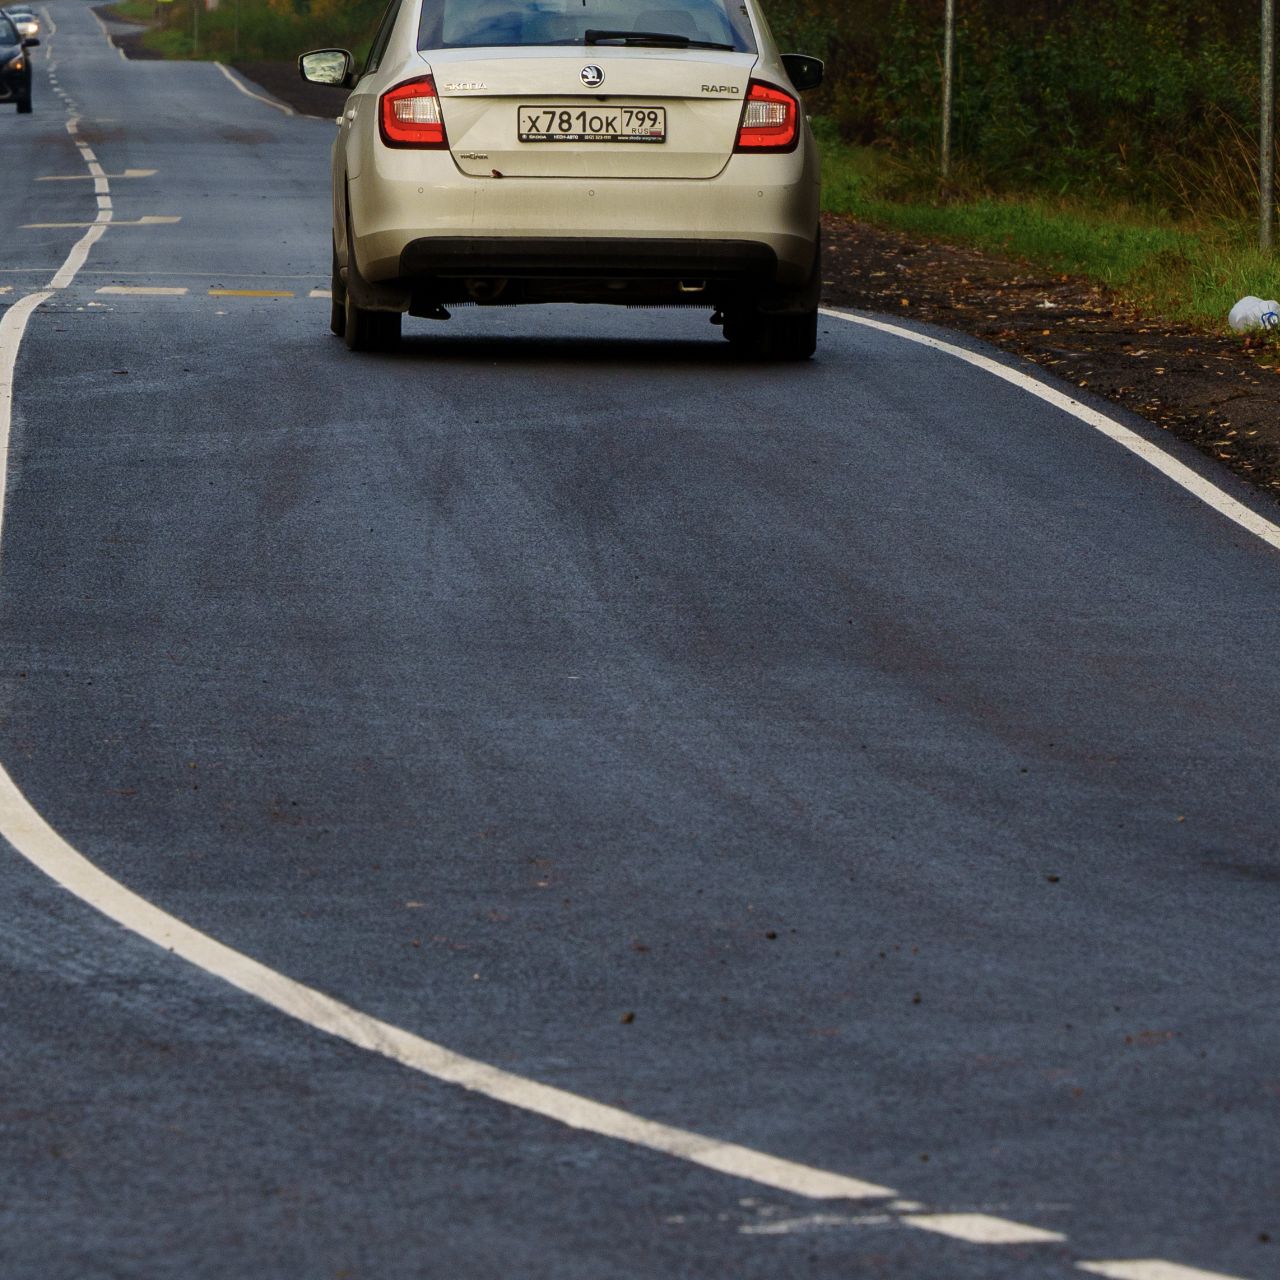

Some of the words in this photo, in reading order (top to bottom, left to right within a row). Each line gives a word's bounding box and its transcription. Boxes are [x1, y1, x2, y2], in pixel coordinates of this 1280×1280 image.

[701, 84, 739, 94] RAPID
[623, 110, 658, 127] 799
[631, 128, 649, 136] RUS
